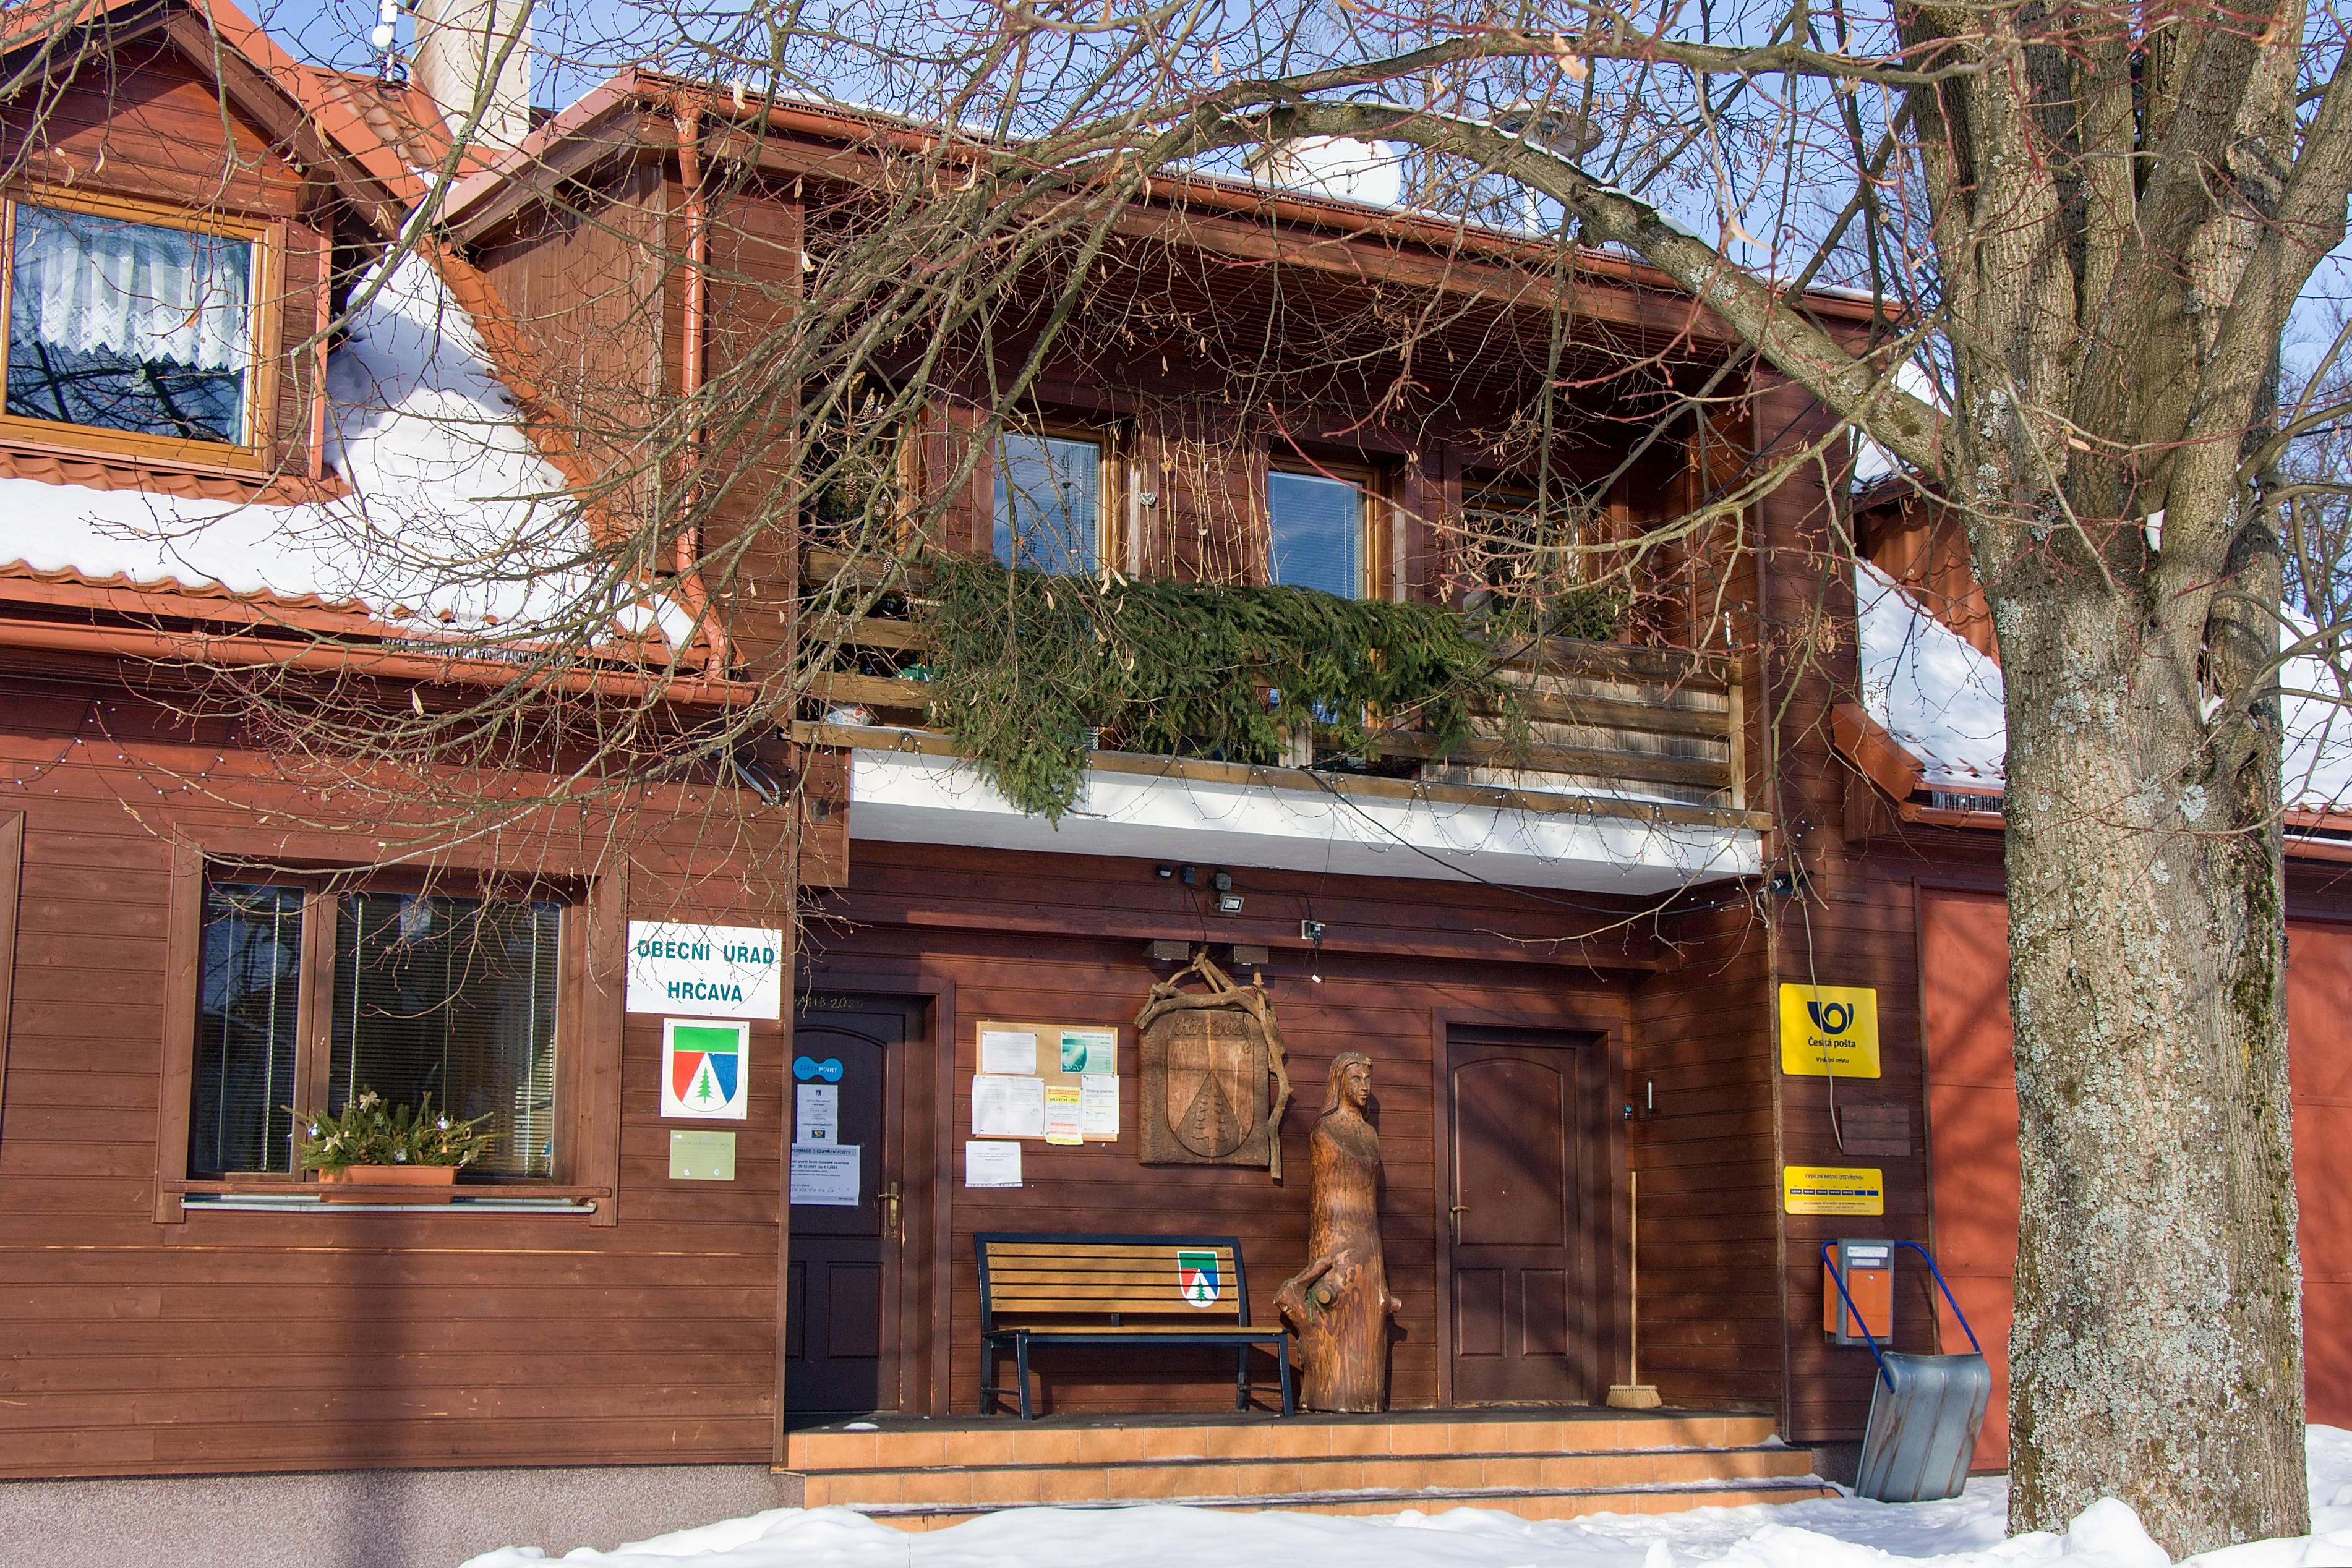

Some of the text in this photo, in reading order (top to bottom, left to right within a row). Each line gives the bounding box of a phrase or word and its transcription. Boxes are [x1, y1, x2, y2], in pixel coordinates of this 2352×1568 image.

[724, 940, 774, 964] ÚŘAD
[668, 978, 742, 1002] HRČAVA
[1808, 1036, 1856, 1049] Česká pošta
